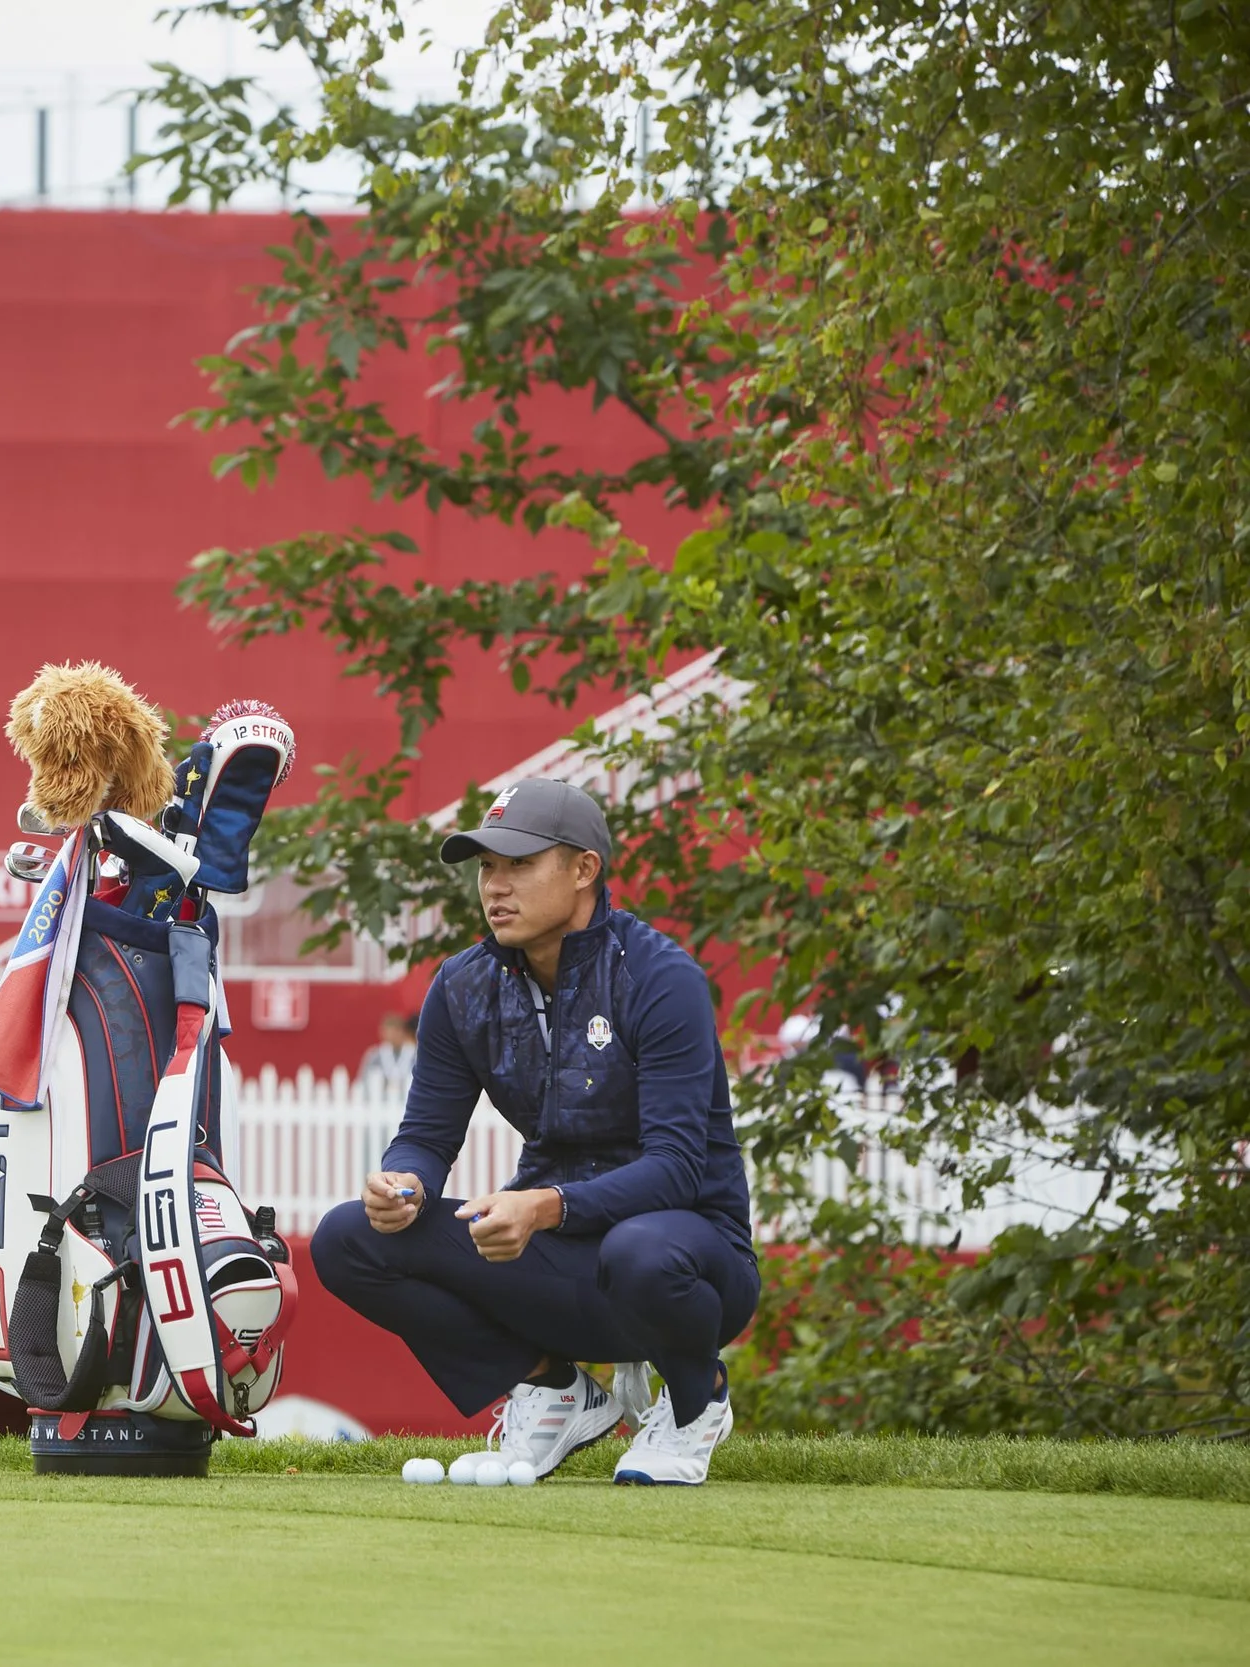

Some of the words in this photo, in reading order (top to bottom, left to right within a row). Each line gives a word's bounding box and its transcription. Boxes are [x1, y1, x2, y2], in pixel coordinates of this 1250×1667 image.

[233, 726, 248, 740] 12
[28, 890, 64, 944] 2020
[144, 1120, 195, 1324] USA
[560, 1395, 576, 1403] USA
[45, 1428, 63, 1440] W
[77, 1428, 144, 1441] STAND
